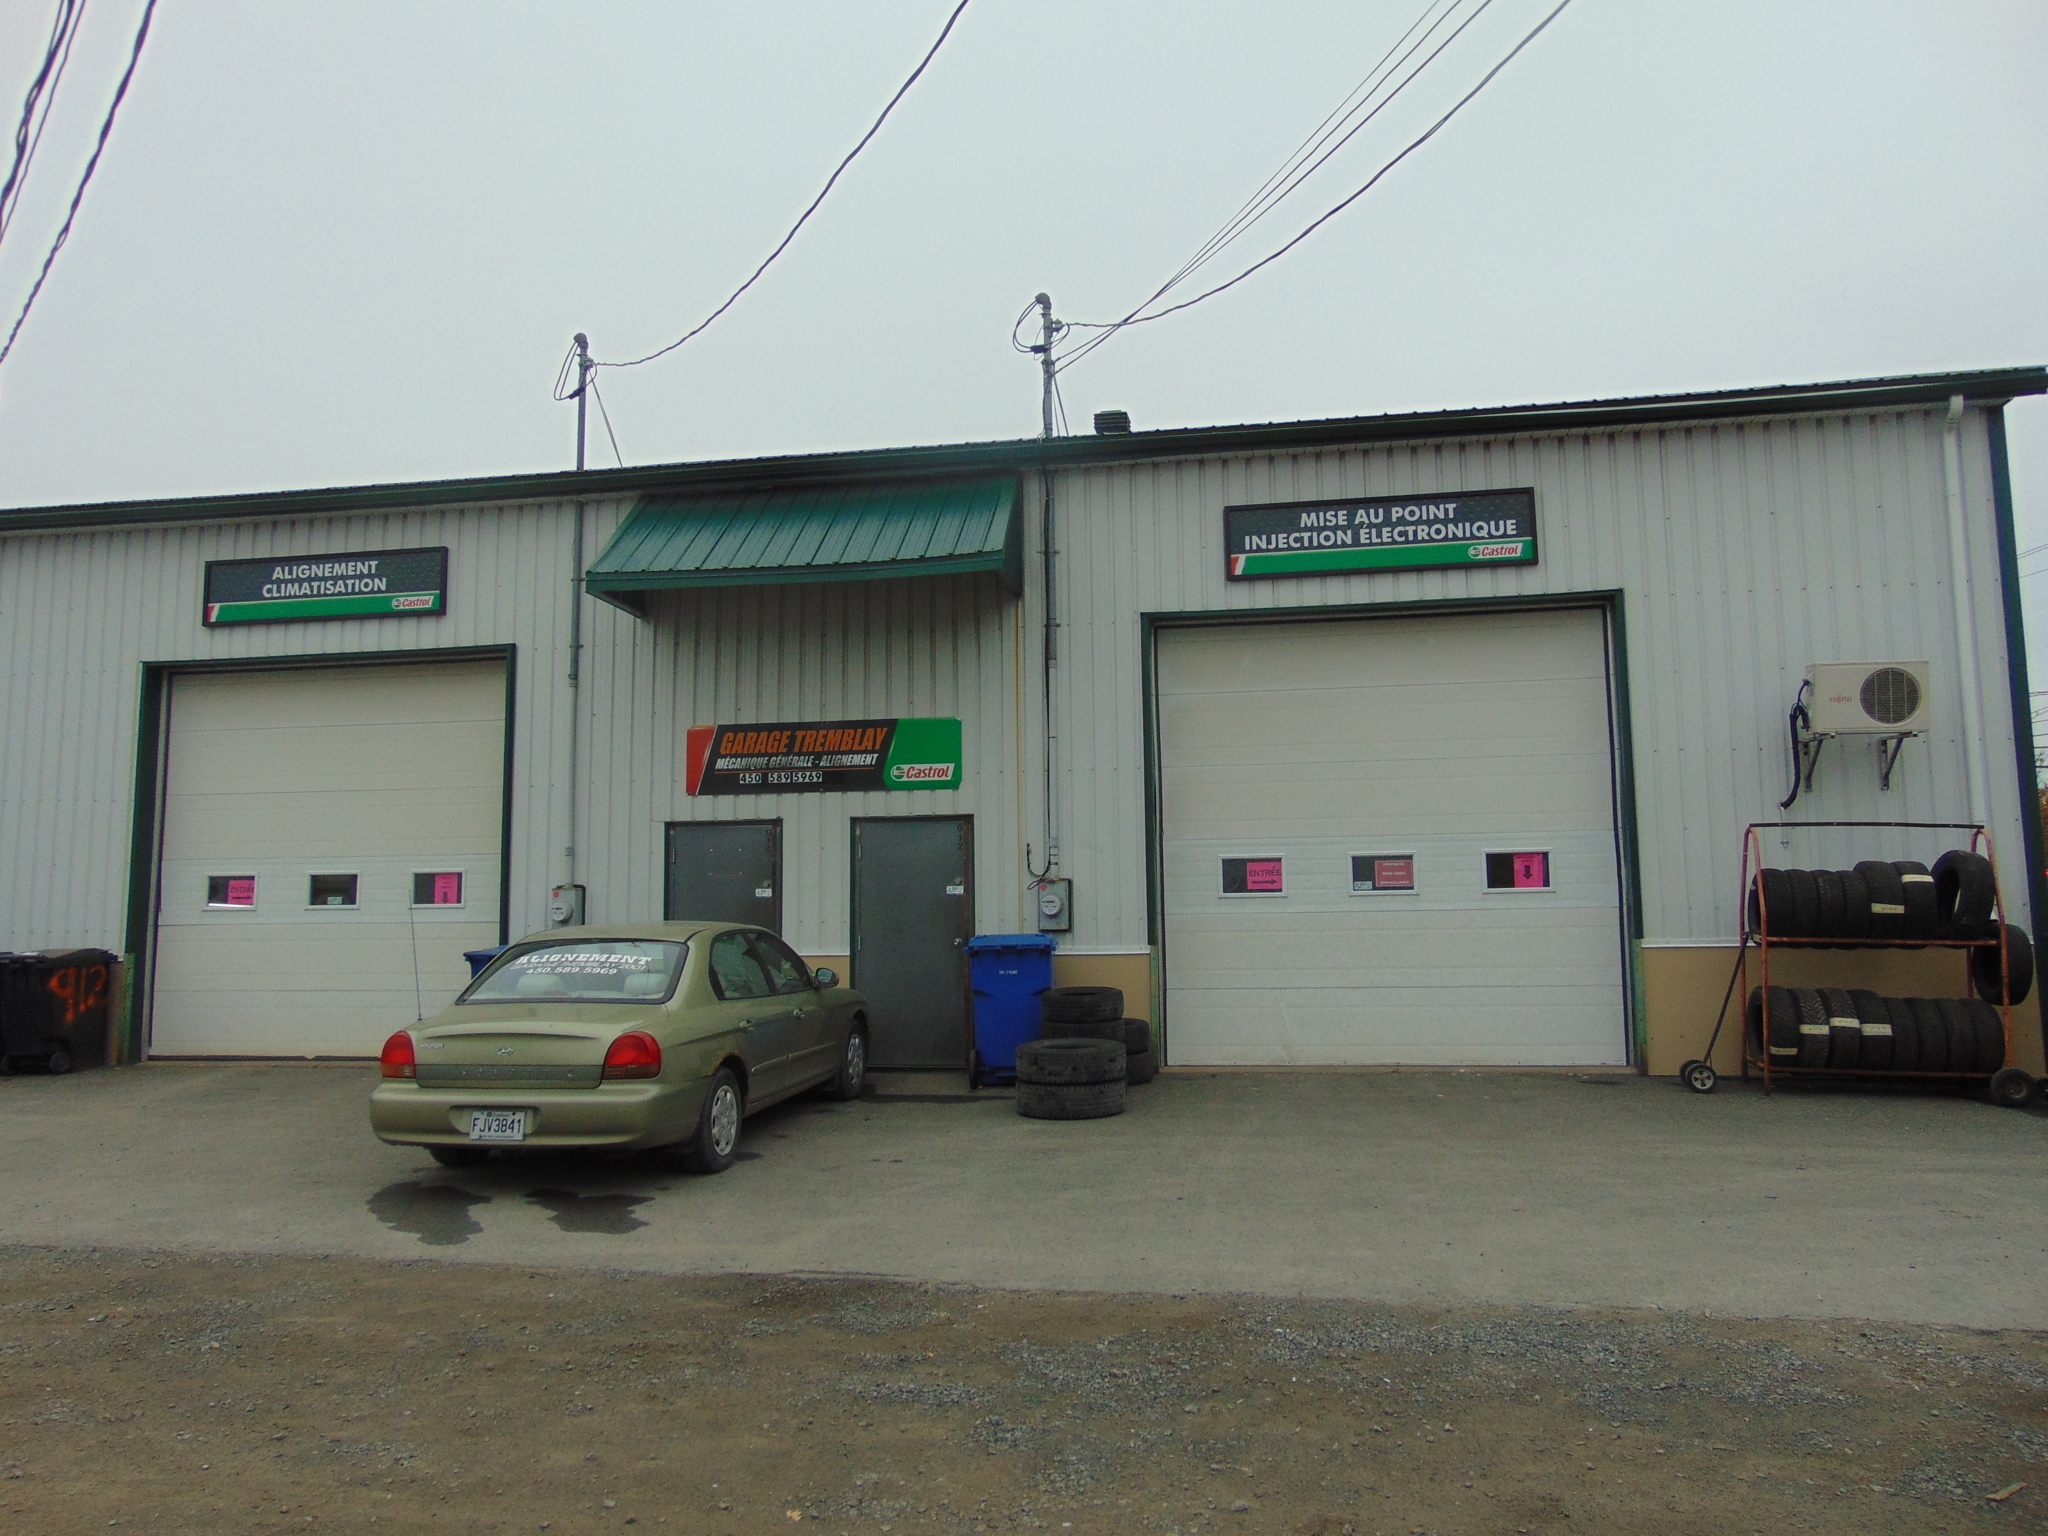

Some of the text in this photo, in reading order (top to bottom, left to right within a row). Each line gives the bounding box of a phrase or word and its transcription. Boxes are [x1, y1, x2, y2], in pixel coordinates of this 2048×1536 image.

[1300, 503, 1457, 528] MISE AU POINT
[1244, 519, 1517, 551] INJECTION ÉLECTRONIQUE
[1481, 544, 1519, 558] Castrol
[272, 560, 379, 580] ALIGNEMENT
[262, 577, 387, 598] CLIMATISATION
[401, 597, 431, 609] Castrol
[1830, 695, 1852, 703] FUJITSU
[720, 727, 888, 755] GARAGE TREMBLAY
[715, 754, 768, 770] MÉCANIQUE
[769, 753, 815, 768] GÉNÉRALE
[819, 753, 879, 767] ALIGNEMENT
[739, 771, 822, 784] 450 589 5969
[905, 765, 950, 780] Castrol
[1248, 865, 1282, 877] ENTRÉE
[515, 953, 651, 965] ALIGNEMENT
[525, 967, 617, 975] 450.589.5969
[471, 1117, 522, 1134] FJV3841
